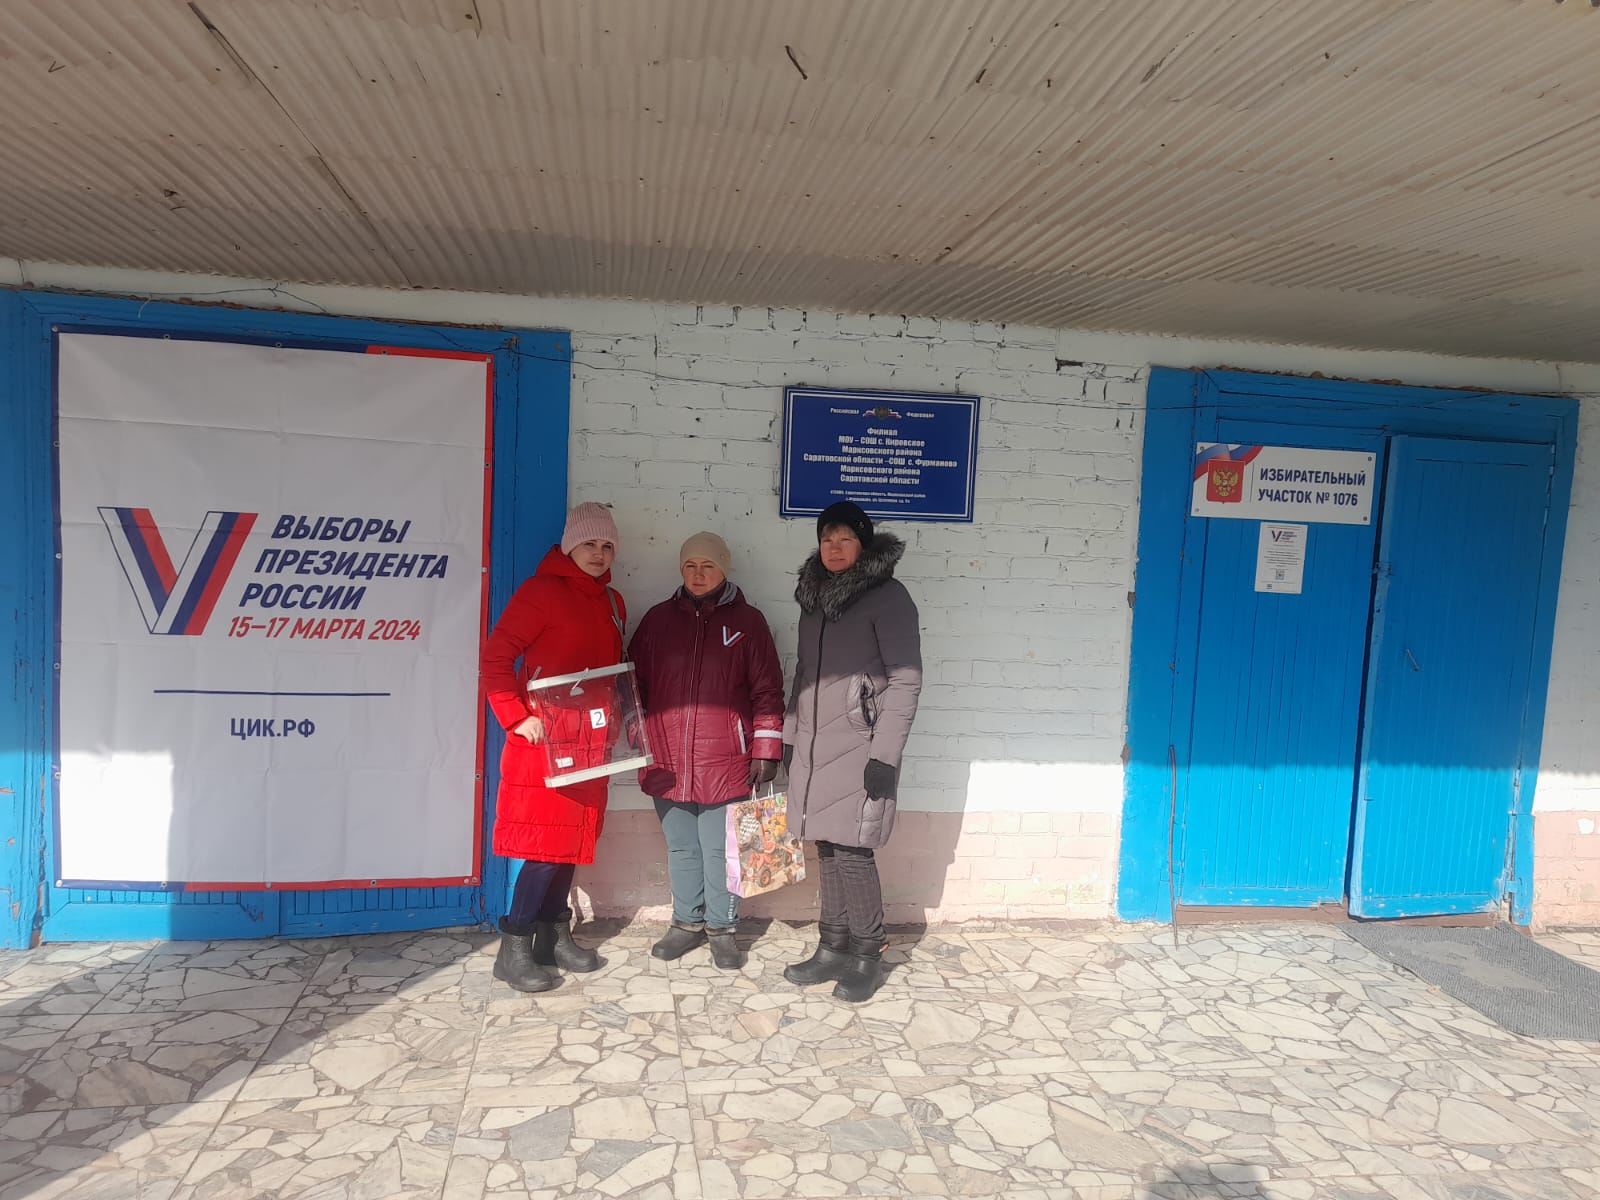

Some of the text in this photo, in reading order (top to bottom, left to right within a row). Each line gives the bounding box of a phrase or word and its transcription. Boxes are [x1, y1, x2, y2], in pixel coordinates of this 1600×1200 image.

[867, 427, 898, 436] Филиал
[838, 435, 854, 444] МОУ
[860, 436, 877, 445] СОШ
[885, 438, 925, 447] Кировское
[803, 453, 851, 463] Саратовской
[853, 455, 883, 464] области
[895, 446, 922, 456] района
[894, 466, 921, 475] района
[1260, 468, 1366, 486] ИЗБИРАТЕЛЬНЫЙ
[840, 474, 919, 485] Саратовской области
[1257, 489, 1359, 506] УЧАСТОК № 1076
[271, 514, 411, 543] ВЫБОРЫ
[254, 549, 449, 580] ПРЕЗИДЕНТА
[239, 582, 367, 611] РОССИИ
[289, 617, 364, 640] МАРТА
[367, 619, 421, 641] 2024
[592, 710, 605, 727] 2
[230, 718, 316, 740] ЦИК.РФ
